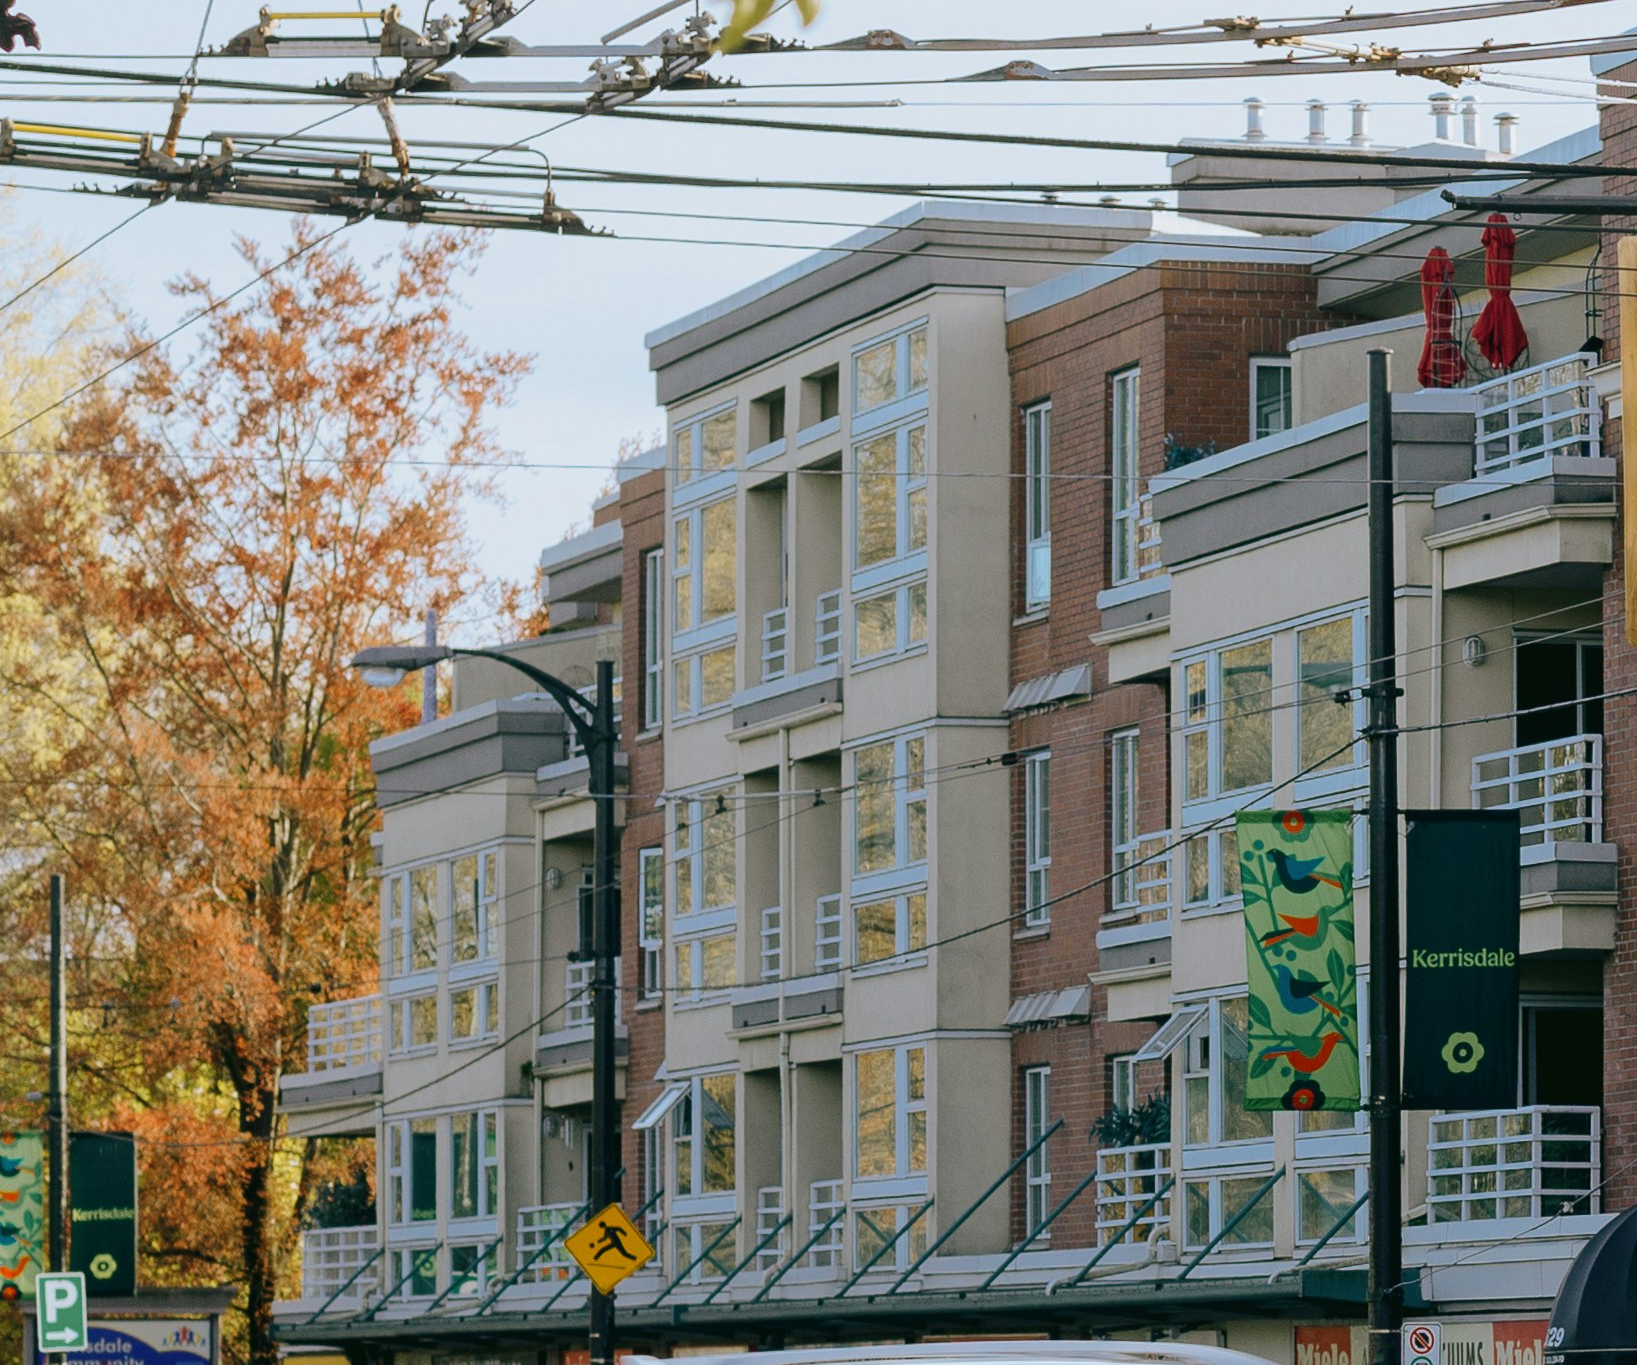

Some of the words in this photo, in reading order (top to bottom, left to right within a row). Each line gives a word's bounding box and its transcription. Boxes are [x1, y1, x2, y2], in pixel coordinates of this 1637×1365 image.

[1411, 947, 1516, 969] Kerrisdale
[72, 1208, 134, 1222] Kerrisdale
[44, 1280, 78, 1323] P
[86, 1337, 132, 1353] sdale
